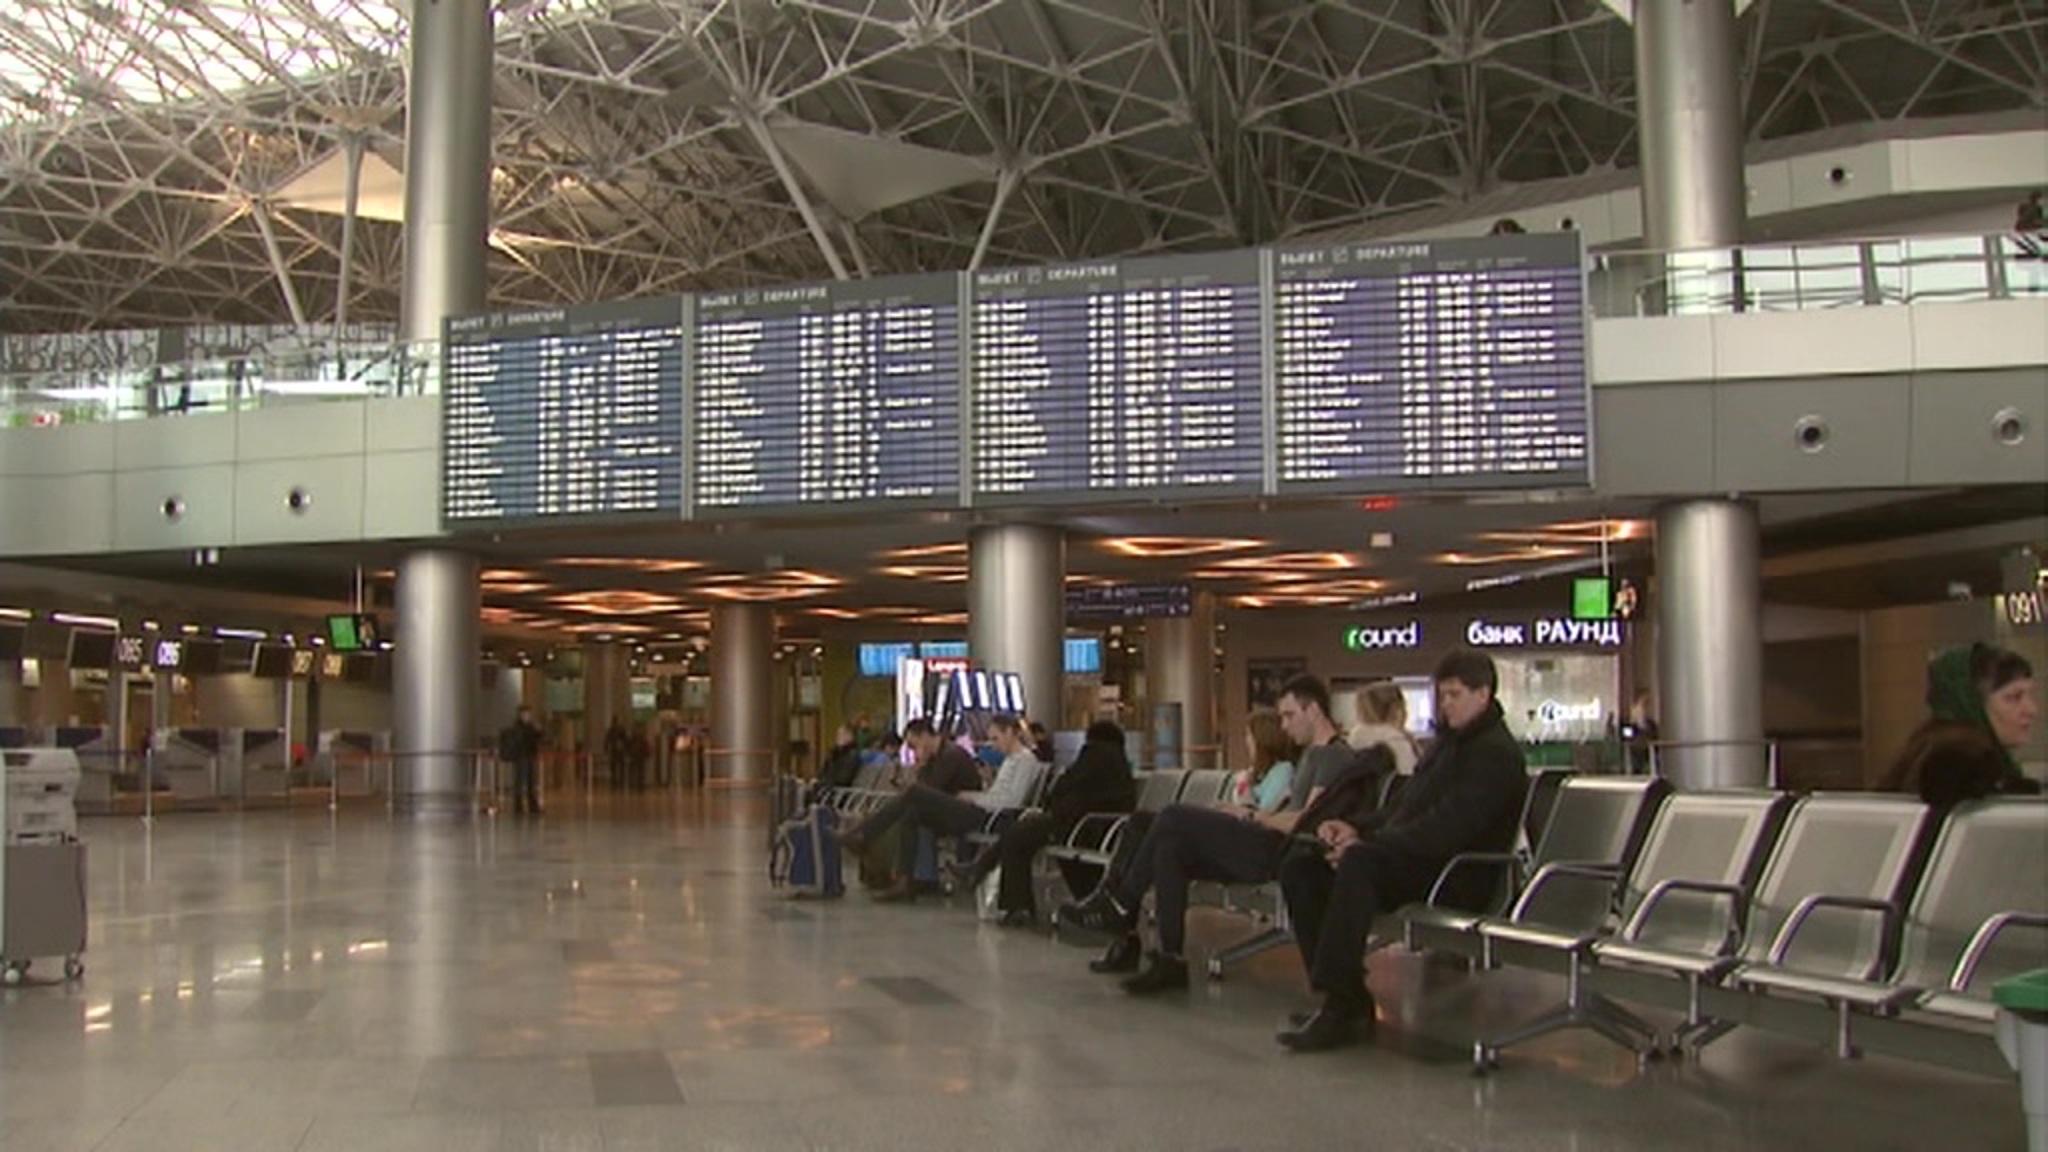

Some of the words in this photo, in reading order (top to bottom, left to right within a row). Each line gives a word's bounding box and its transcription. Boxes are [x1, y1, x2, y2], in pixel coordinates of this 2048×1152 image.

[1356, 244, 1430, 260] DEPARTURE
[1048, 265, 1117, 280] DEPARTURE
[2008, 592, 2041, 624] 091
[1346, 621, 1417, 648] round
[1468, 621, 1523, 644] банк
[1535, 619, 1620, 644] РАУНД
